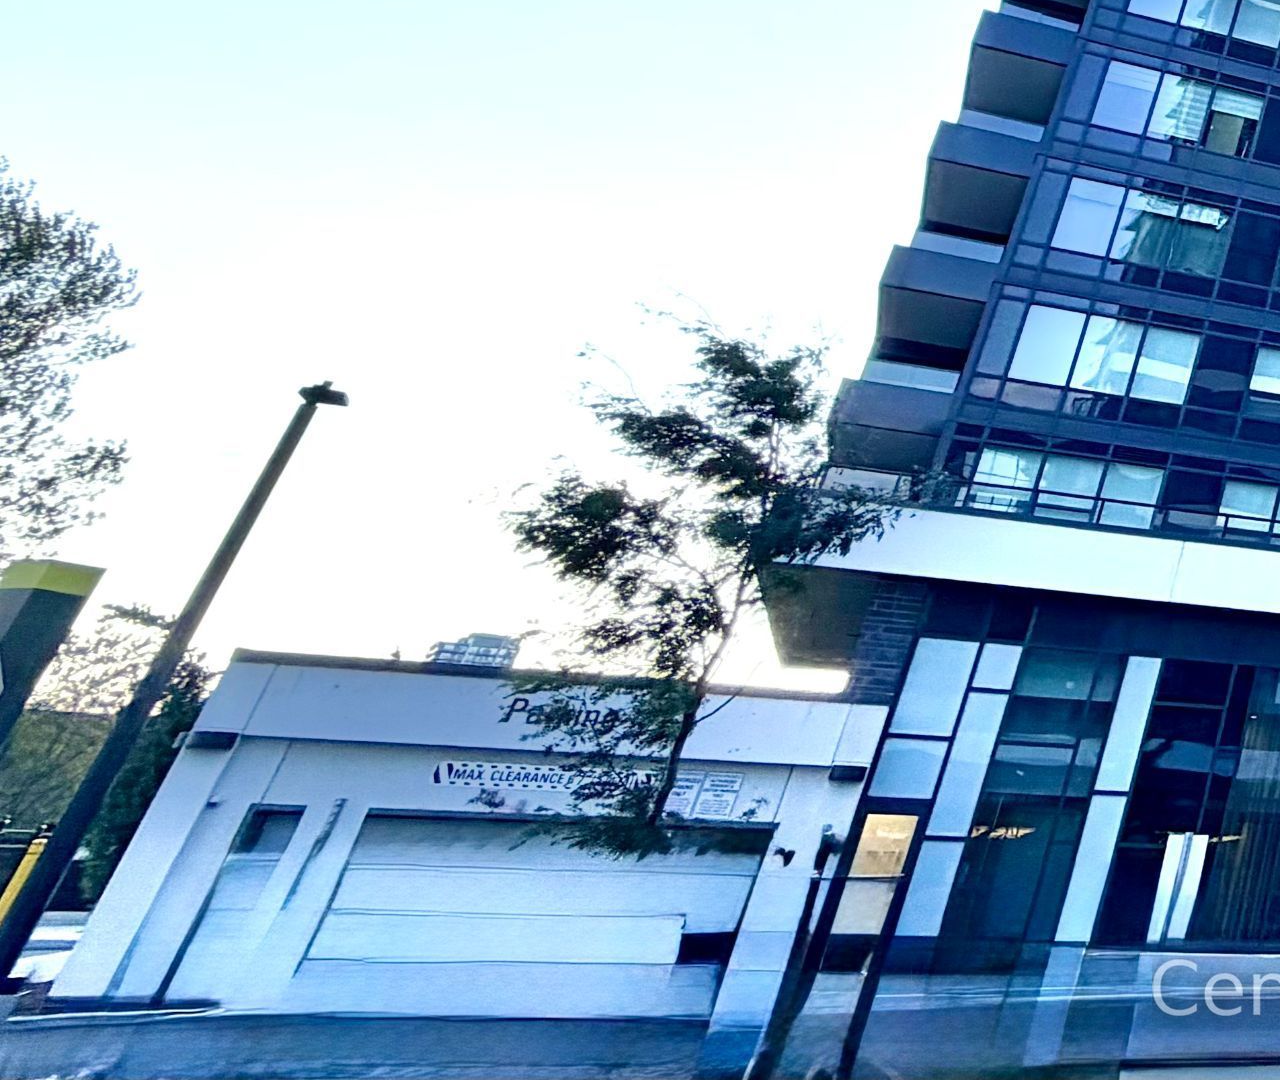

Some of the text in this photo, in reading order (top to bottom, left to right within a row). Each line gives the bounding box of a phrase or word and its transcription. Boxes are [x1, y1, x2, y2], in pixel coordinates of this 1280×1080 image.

[498, 697, 621, 736] Paing
[453, 769, 485, 781] MAX
[490, 770, 564, 784] CLEARANCE
